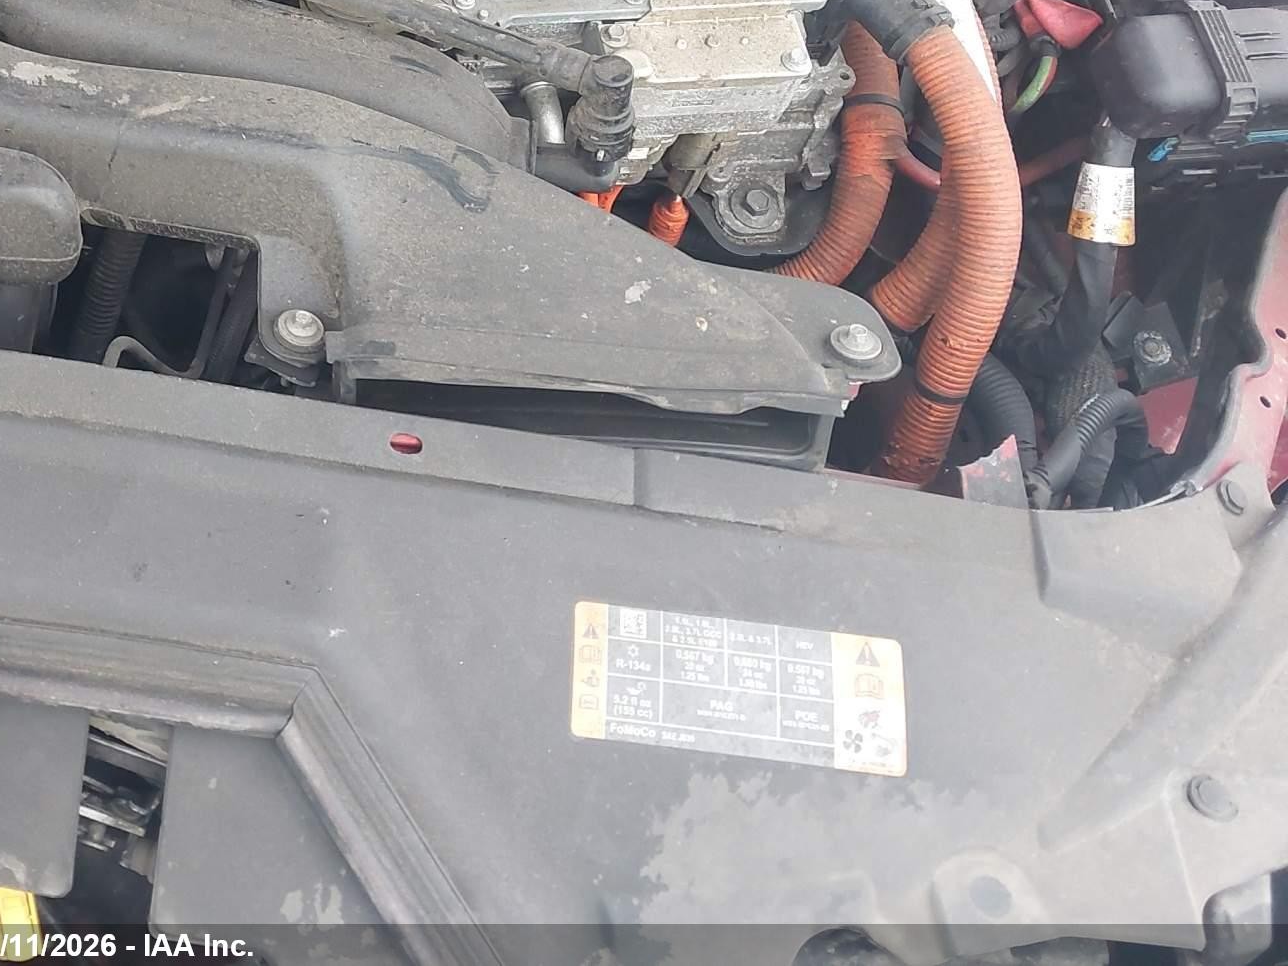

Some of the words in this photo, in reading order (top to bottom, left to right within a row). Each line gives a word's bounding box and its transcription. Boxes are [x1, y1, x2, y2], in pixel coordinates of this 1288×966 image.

[615, 658, 651, 672] R-134a
[709, 699, 734, 712] PAG
[610, 722, 657, 738] FoMoCo
